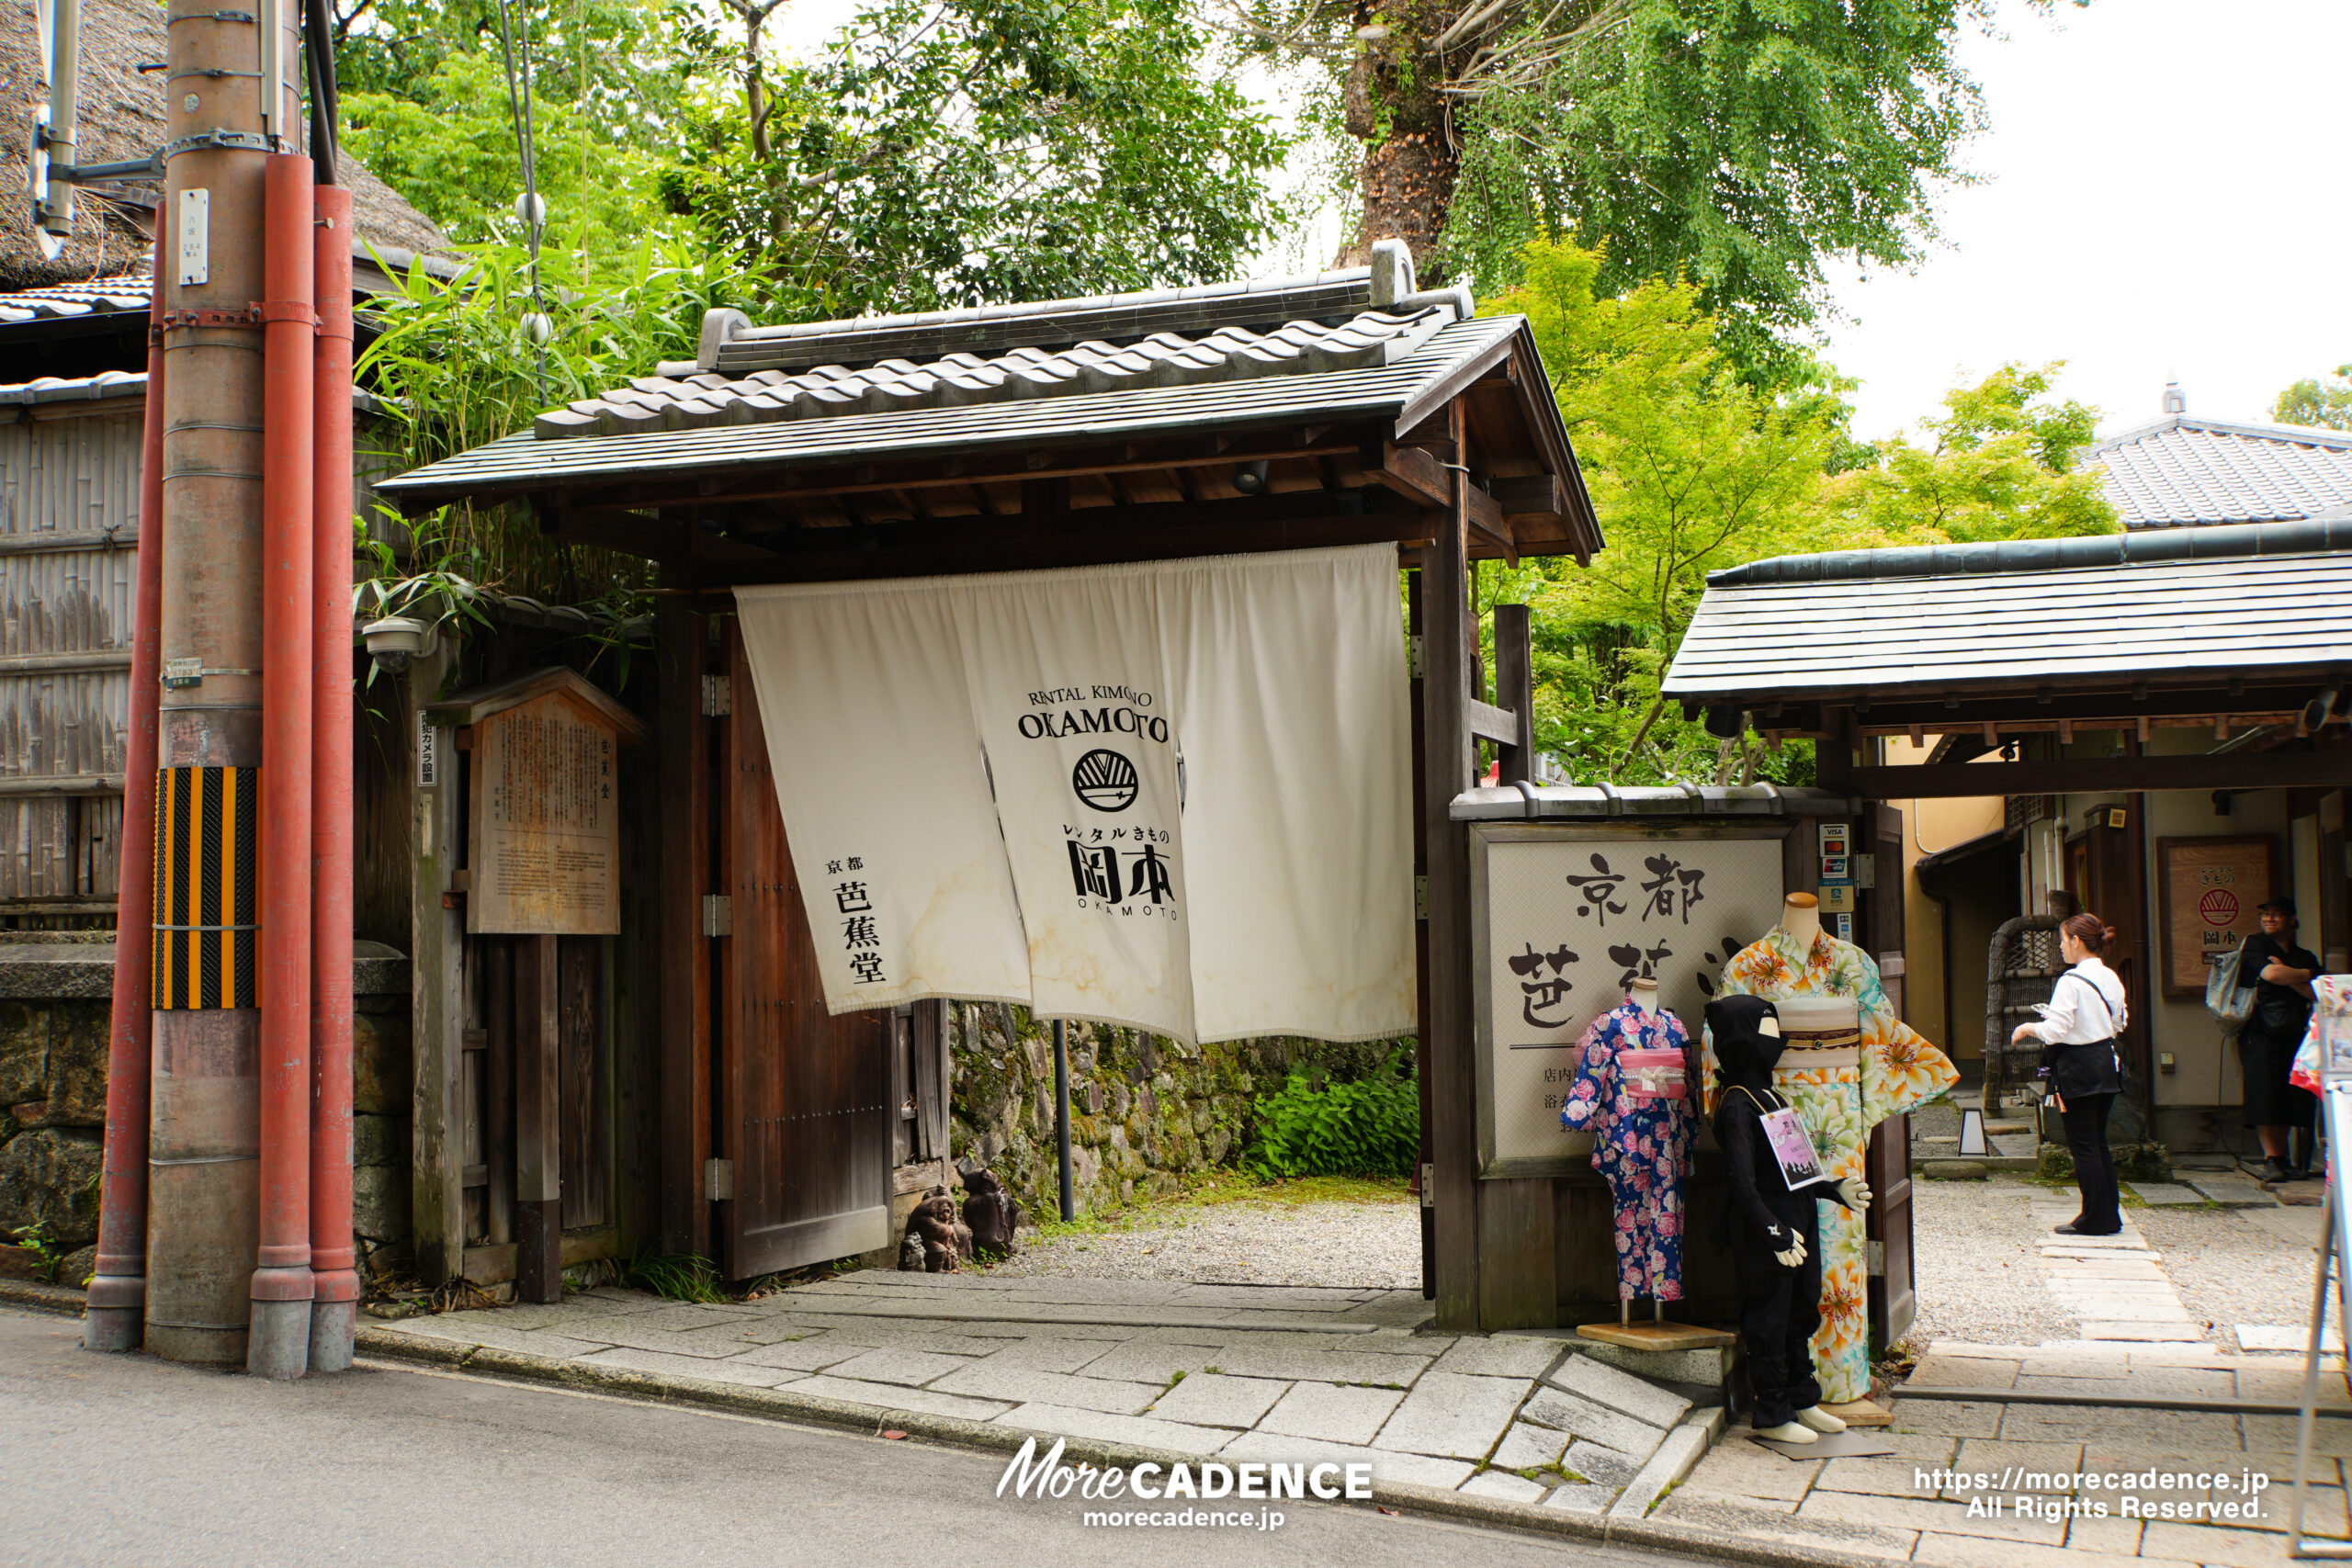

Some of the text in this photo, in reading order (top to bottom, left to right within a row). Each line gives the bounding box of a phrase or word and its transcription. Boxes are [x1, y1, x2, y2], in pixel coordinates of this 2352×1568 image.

[1018, 708, 1169, 743] OKAMOTO
[1063, 824, 1170, 843] レンタルきもの
[825, 856, 864, 875] 京都
[1067, 840, 1175, 905] 岡本
[1566, 852, 1705, 927] 京都
[2200, 874, 2235, 885] きもの
[1078, 898, 1177, 920] OKAMOTO
[831, 881, 887, 985] 芭蕉堂
[1544, 1067, 1577, 1082] 店内
